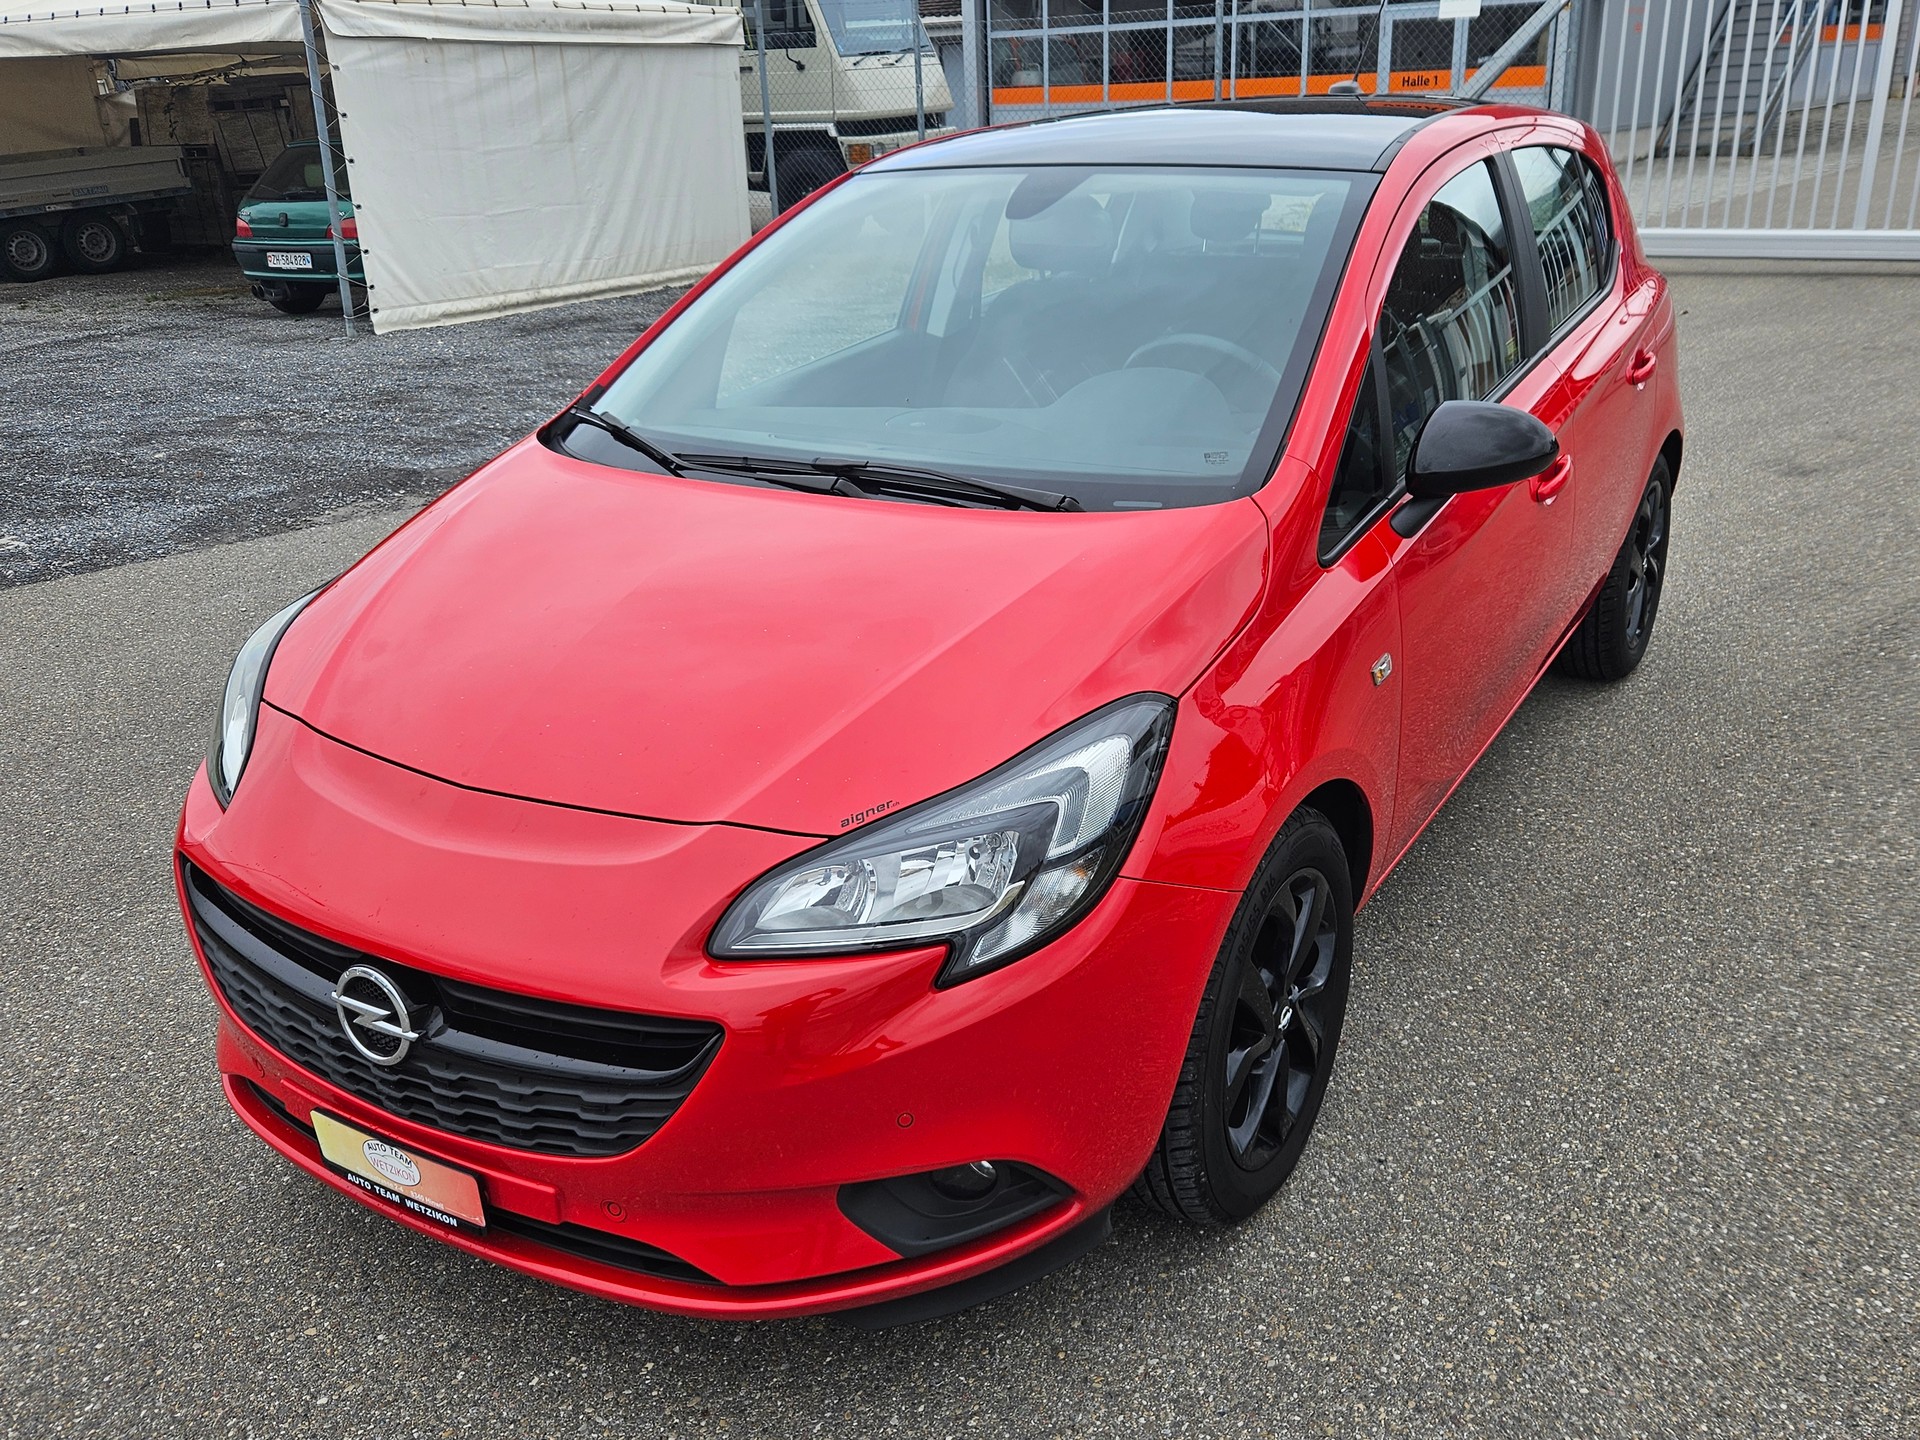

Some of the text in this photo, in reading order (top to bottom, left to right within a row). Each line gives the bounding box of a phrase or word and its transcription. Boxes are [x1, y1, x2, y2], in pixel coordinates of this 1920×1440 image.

[1402, 75, 1430, 87] Halle
[367, 1142, 412, 1167] AUTO TEAM
[370, 1157, 415, 1183] WETZIKON
[347, 1173, 371, 1190] AUTO
[374, 1185, 401, 1203] TEAM
[405, 1198, 458, 1227] WETZIKON
